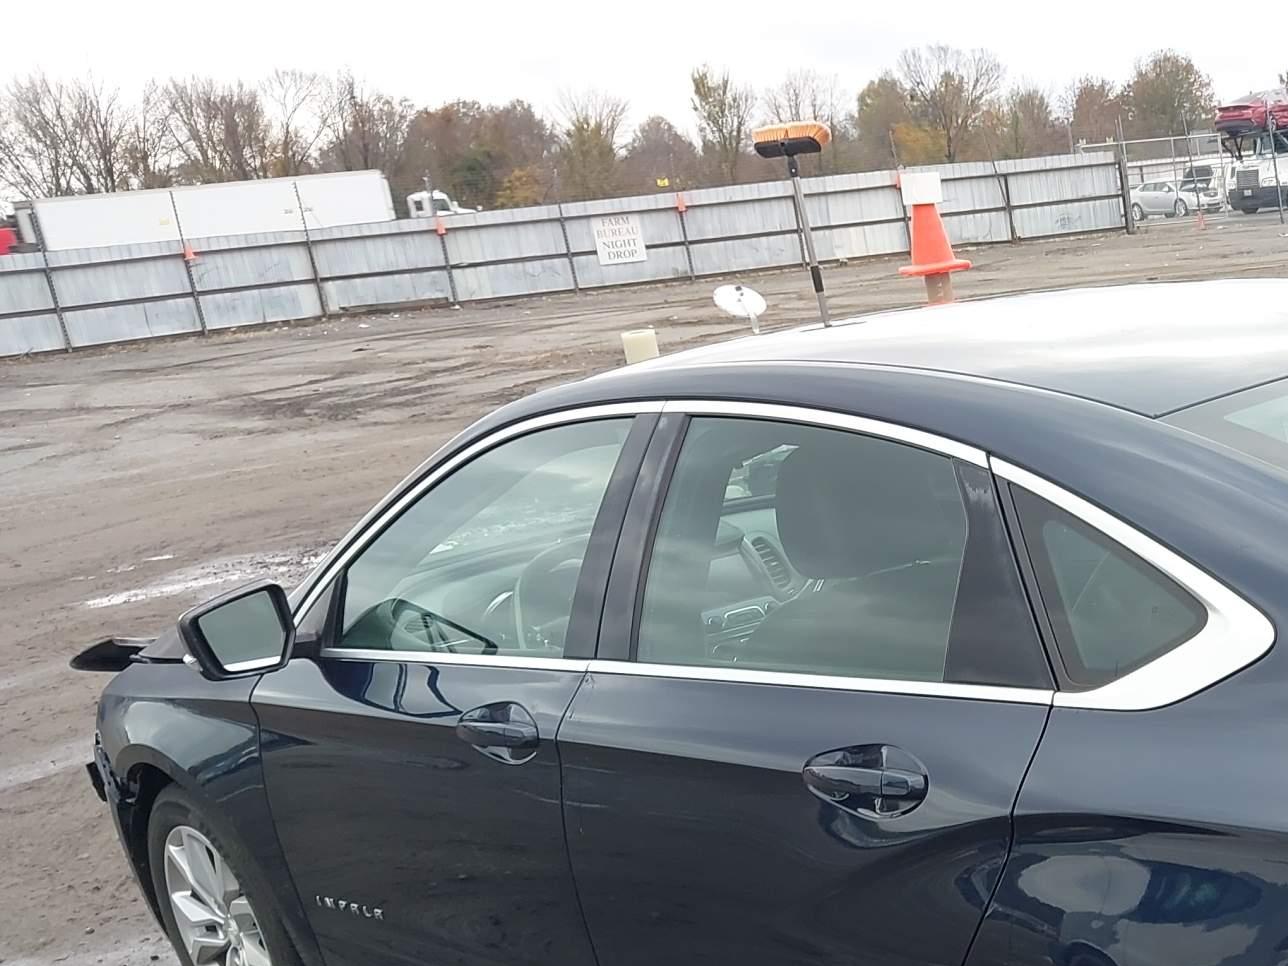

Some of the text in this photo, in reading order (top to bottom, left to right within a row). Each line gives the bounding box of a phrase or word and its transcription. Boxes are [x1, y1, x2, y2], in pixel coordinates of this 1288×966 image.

[601, 215, 630, 227] FARM
[596, 226, 638, 239] BUREAU
[602, 239, 637, 249] NIGHT
[607, 249, 638, 260] DROP
[315, 895, 384, 920] IMPALA
